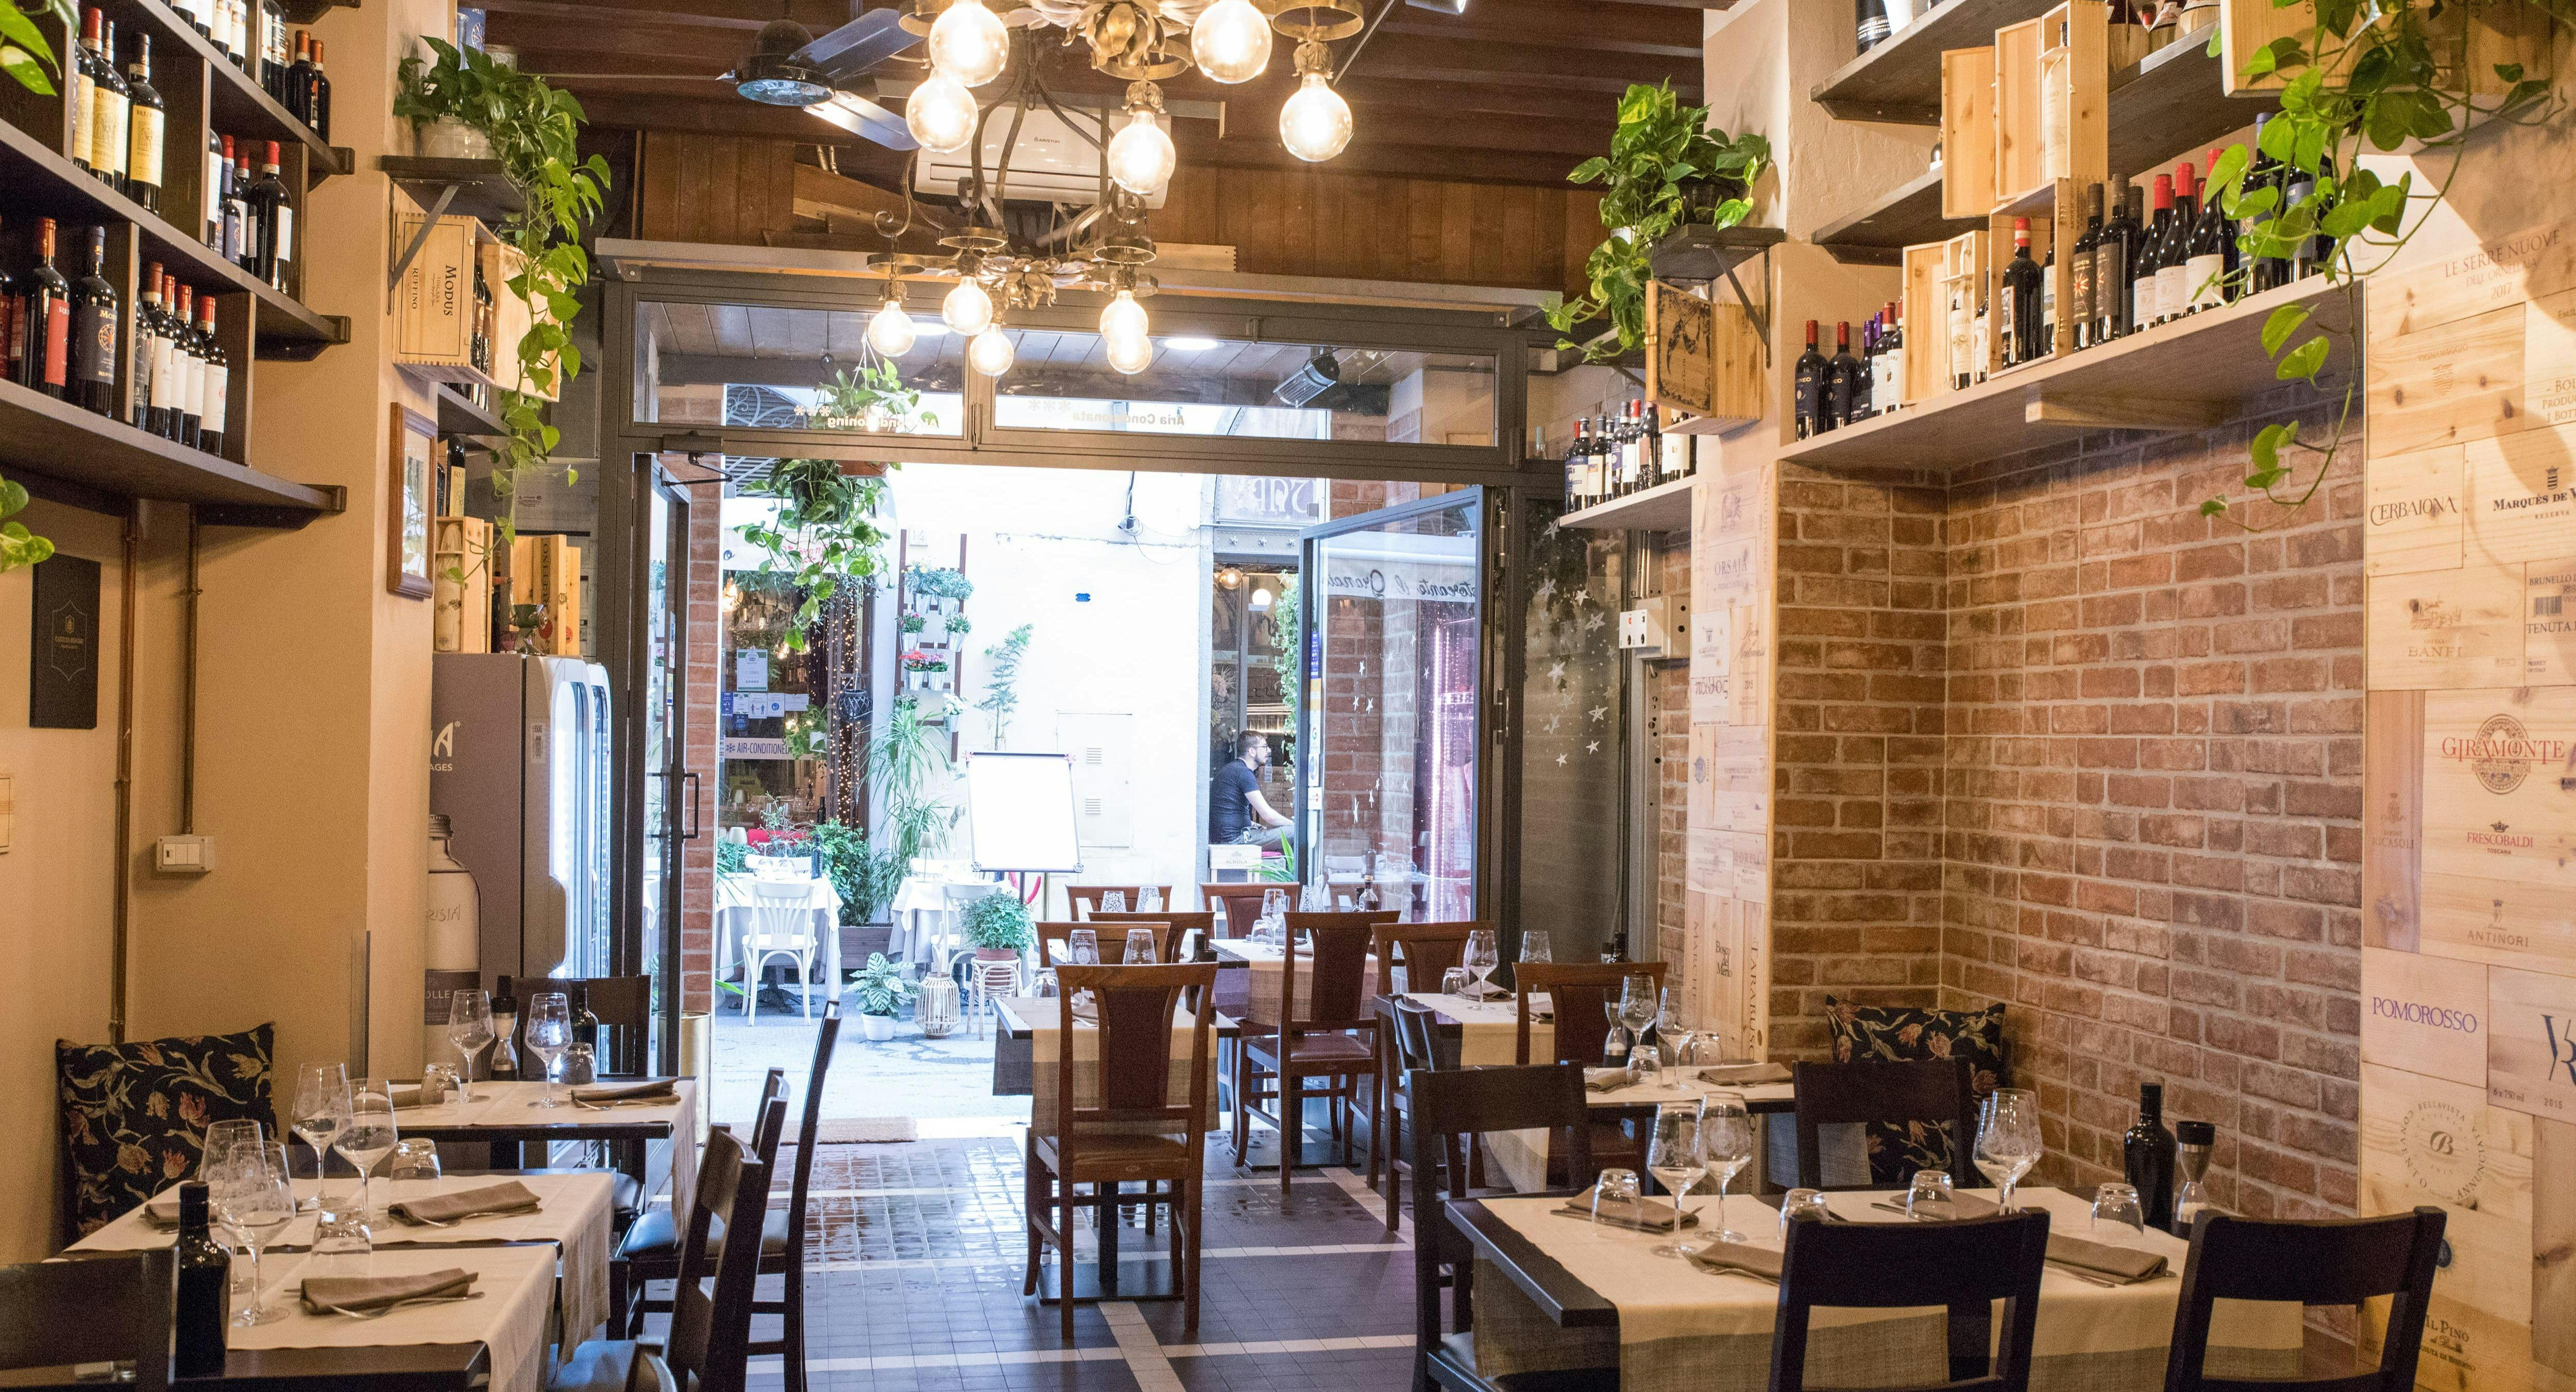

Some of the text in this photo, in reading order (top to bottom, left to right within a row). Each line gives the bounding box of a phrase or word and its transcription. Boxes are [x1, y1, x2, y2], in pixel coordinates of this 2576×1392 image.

[1868, 27, 1891, 36] SELEZION
[2445, 230, 2560, 278] LE SERRE NUOVE
[444, 265, 457, 316] MODUS
[2490, 282, 2512, 300] 2017
[99, 310, 116, 320] MOD
[2553, 493, 2567, 502] DE
[2370, 496, 2458, 526] CERBAIONA
[2535, 510, 2570, 519] RESERVA
[2529, 574, 2571, 586] BRUNELLO
[2526, 621, 2571, 634] TENUTA
[2408, 647, 2462, 657] BANFI
[2442, 737, 2565, 764] GIRAMONTE
[430, 763, 453, 772] AGES
[2467, 832, 2534, 848] FRESCOBALDI
[2467, 930, 2529, 947] ANTINORI
[2372, 997, 2477, 1033] POMOROSSO
[2417, 1101, 2465, 1122] BELLAVISTA
[2441, 1320, 2469, 1343] PINO
